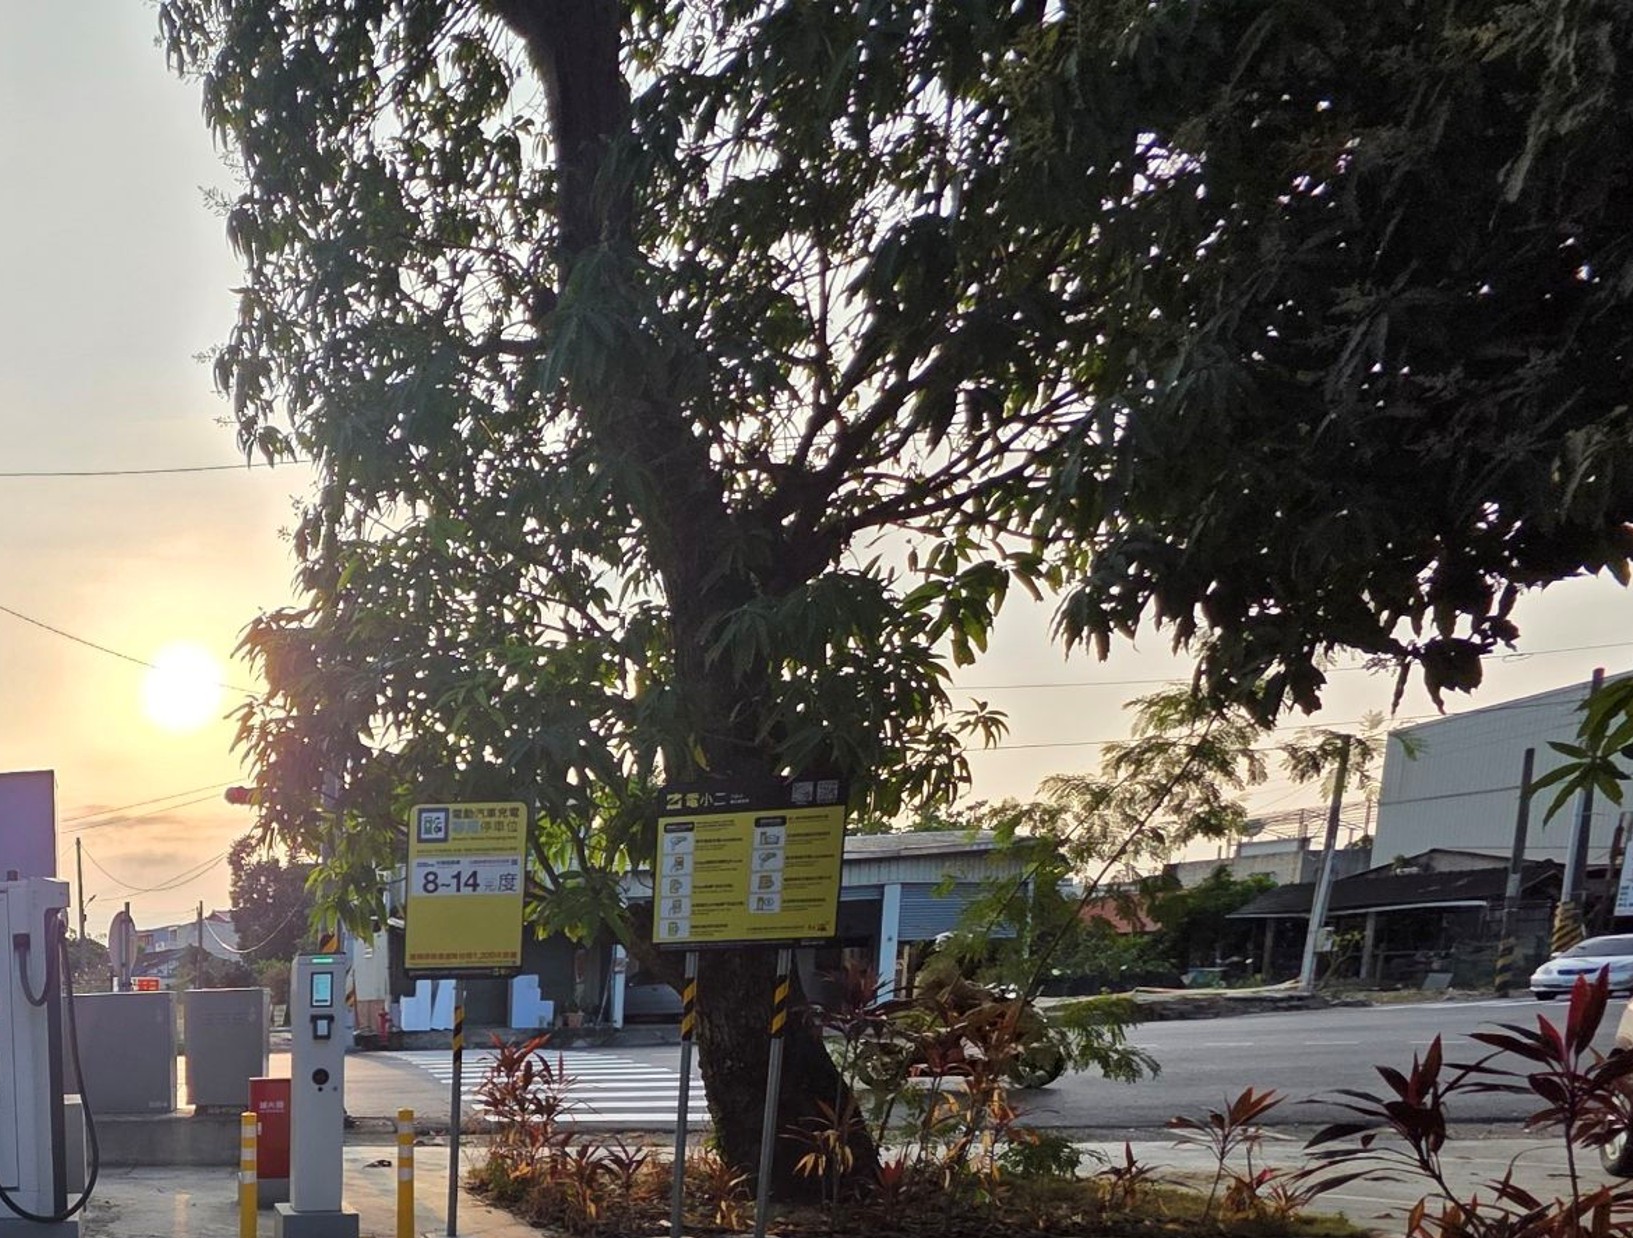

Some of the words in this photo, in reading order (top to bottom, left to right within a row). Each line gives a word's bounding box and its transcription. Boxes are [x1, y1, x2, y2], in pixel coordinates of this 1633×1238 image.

[685, 792, 727, 808] 電小二
[451, 806, 520, 820] 電動汽車充電
[422, 870, 480, 894] 8~14
